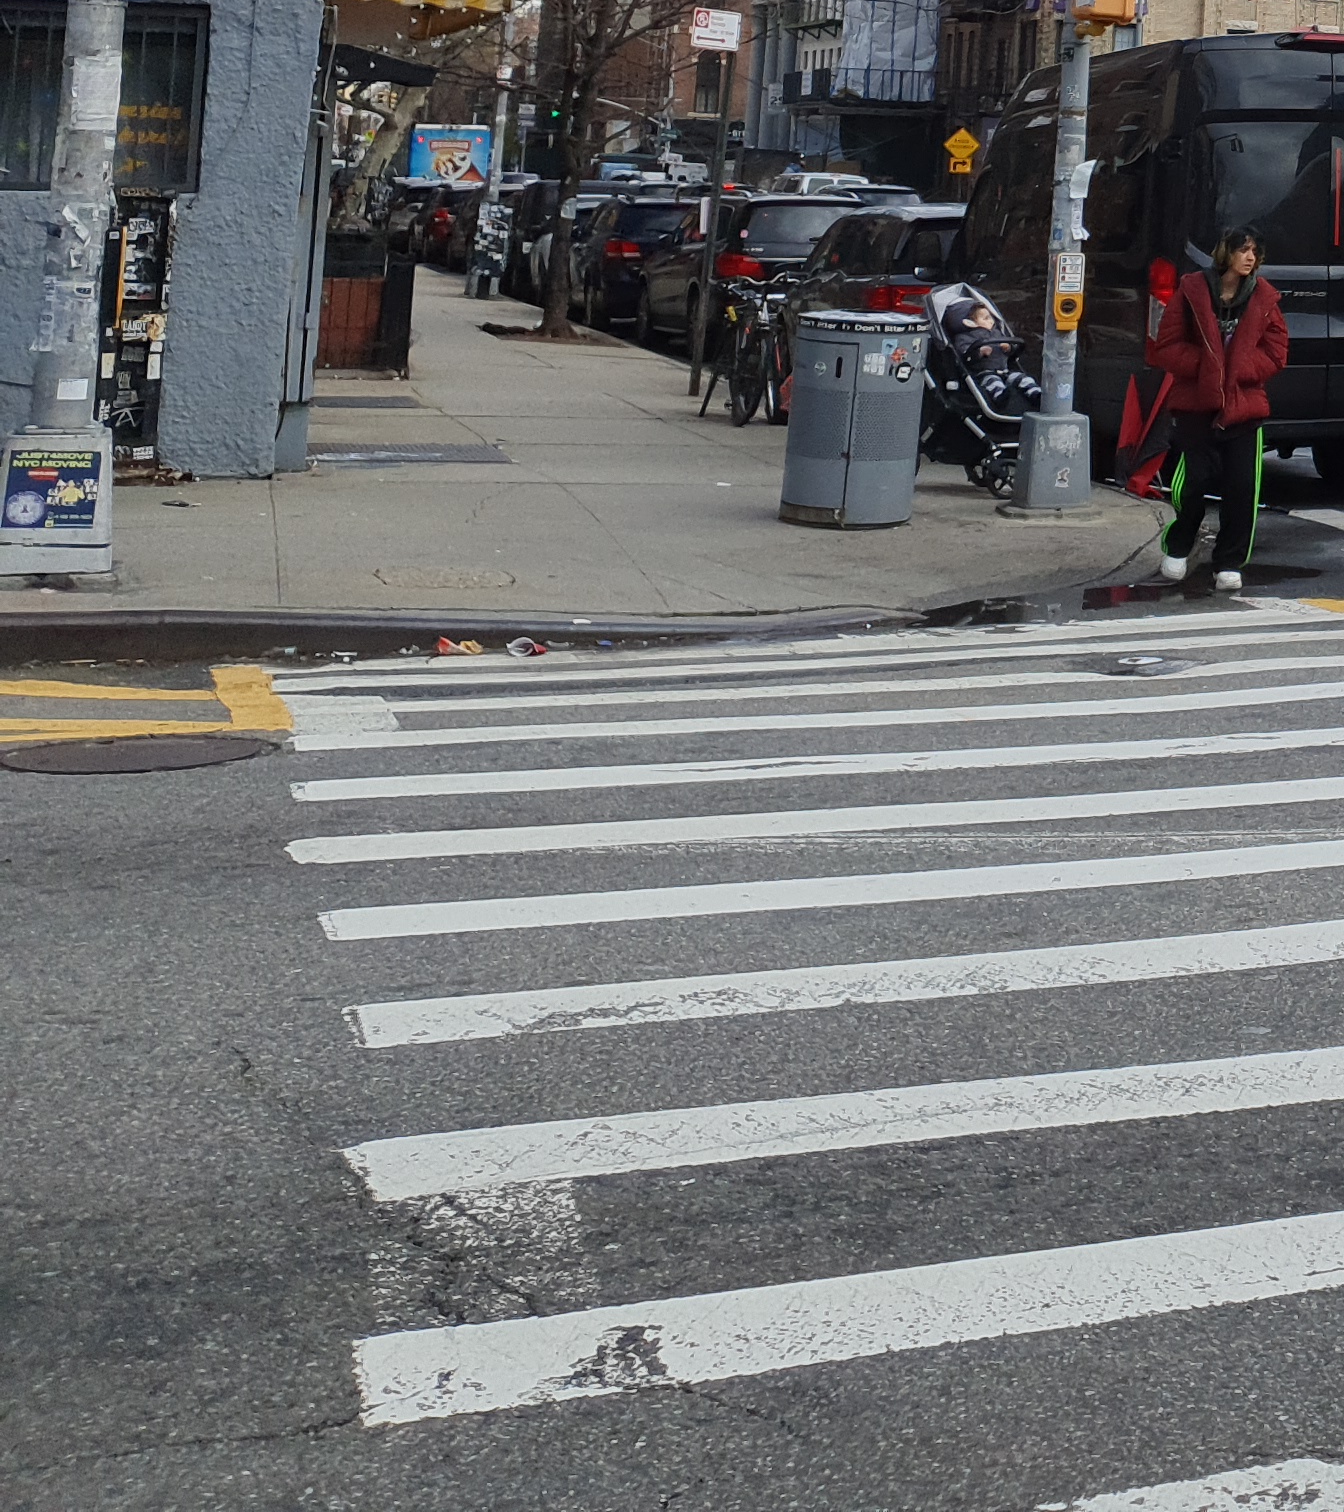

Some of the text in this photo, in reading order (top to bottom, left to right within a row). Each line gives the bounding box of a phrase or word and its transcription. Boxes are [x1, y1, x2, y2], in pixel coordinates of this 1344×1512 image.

[854, 324, 881, 332] Don't
[12, 459, 92, 468] NYC MOVING
